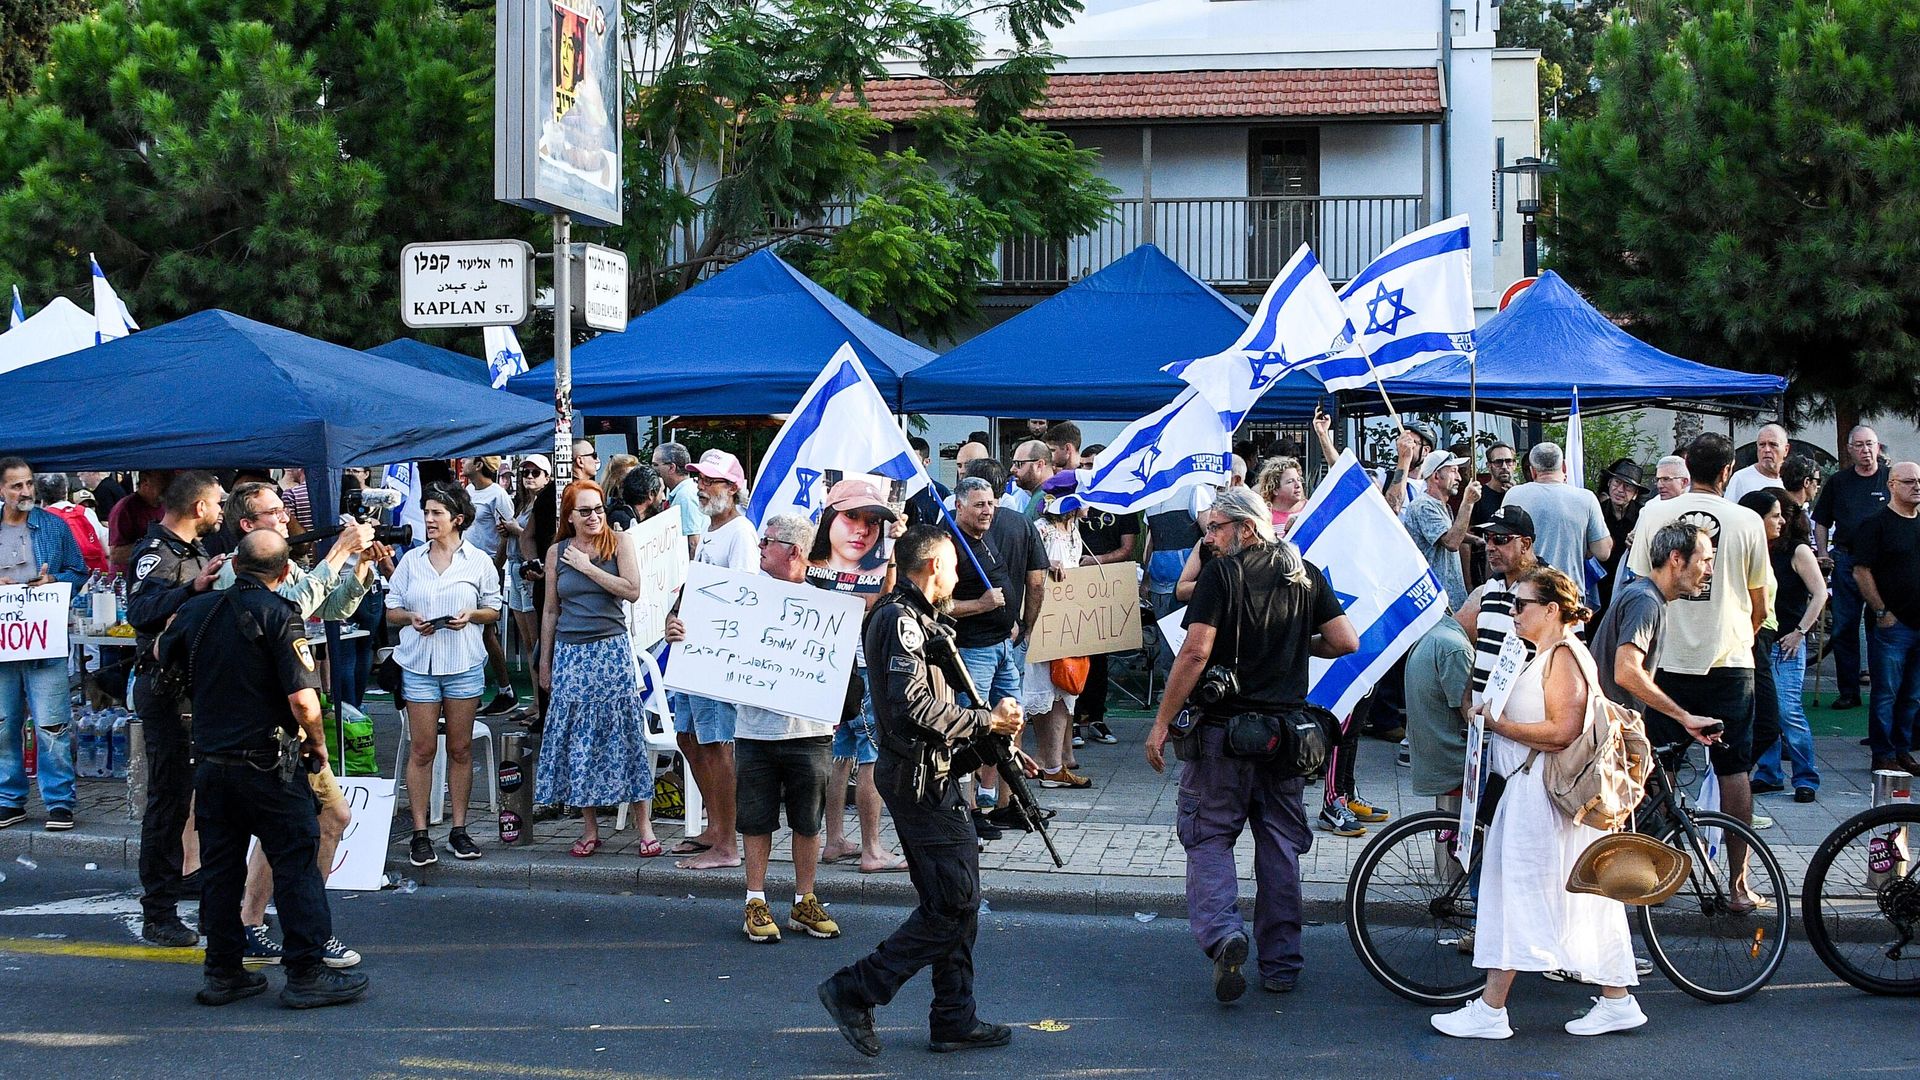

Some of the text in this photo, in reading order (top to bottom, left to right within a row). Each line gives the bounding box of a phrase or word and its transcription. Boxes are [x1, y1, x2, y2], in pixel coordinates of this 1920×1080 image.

[414, 251, 513, 275] רח' אליעזר קפלן
[414, 301, 513, 315] KAPLAN ST.
[1191, 455, 1223, 464] חופשי
[807, 566, 884, 586] BRING LIRI BACK
[0, 586, 59, 608] ring Them
[1087, 580, 1122, 599] our
[0, 610, 26, 621] ome
[780, 596, 846, 639] מחדל
[1042, 601, 1135, 647] FAMILY
[712, 619, 739, 639] 73
